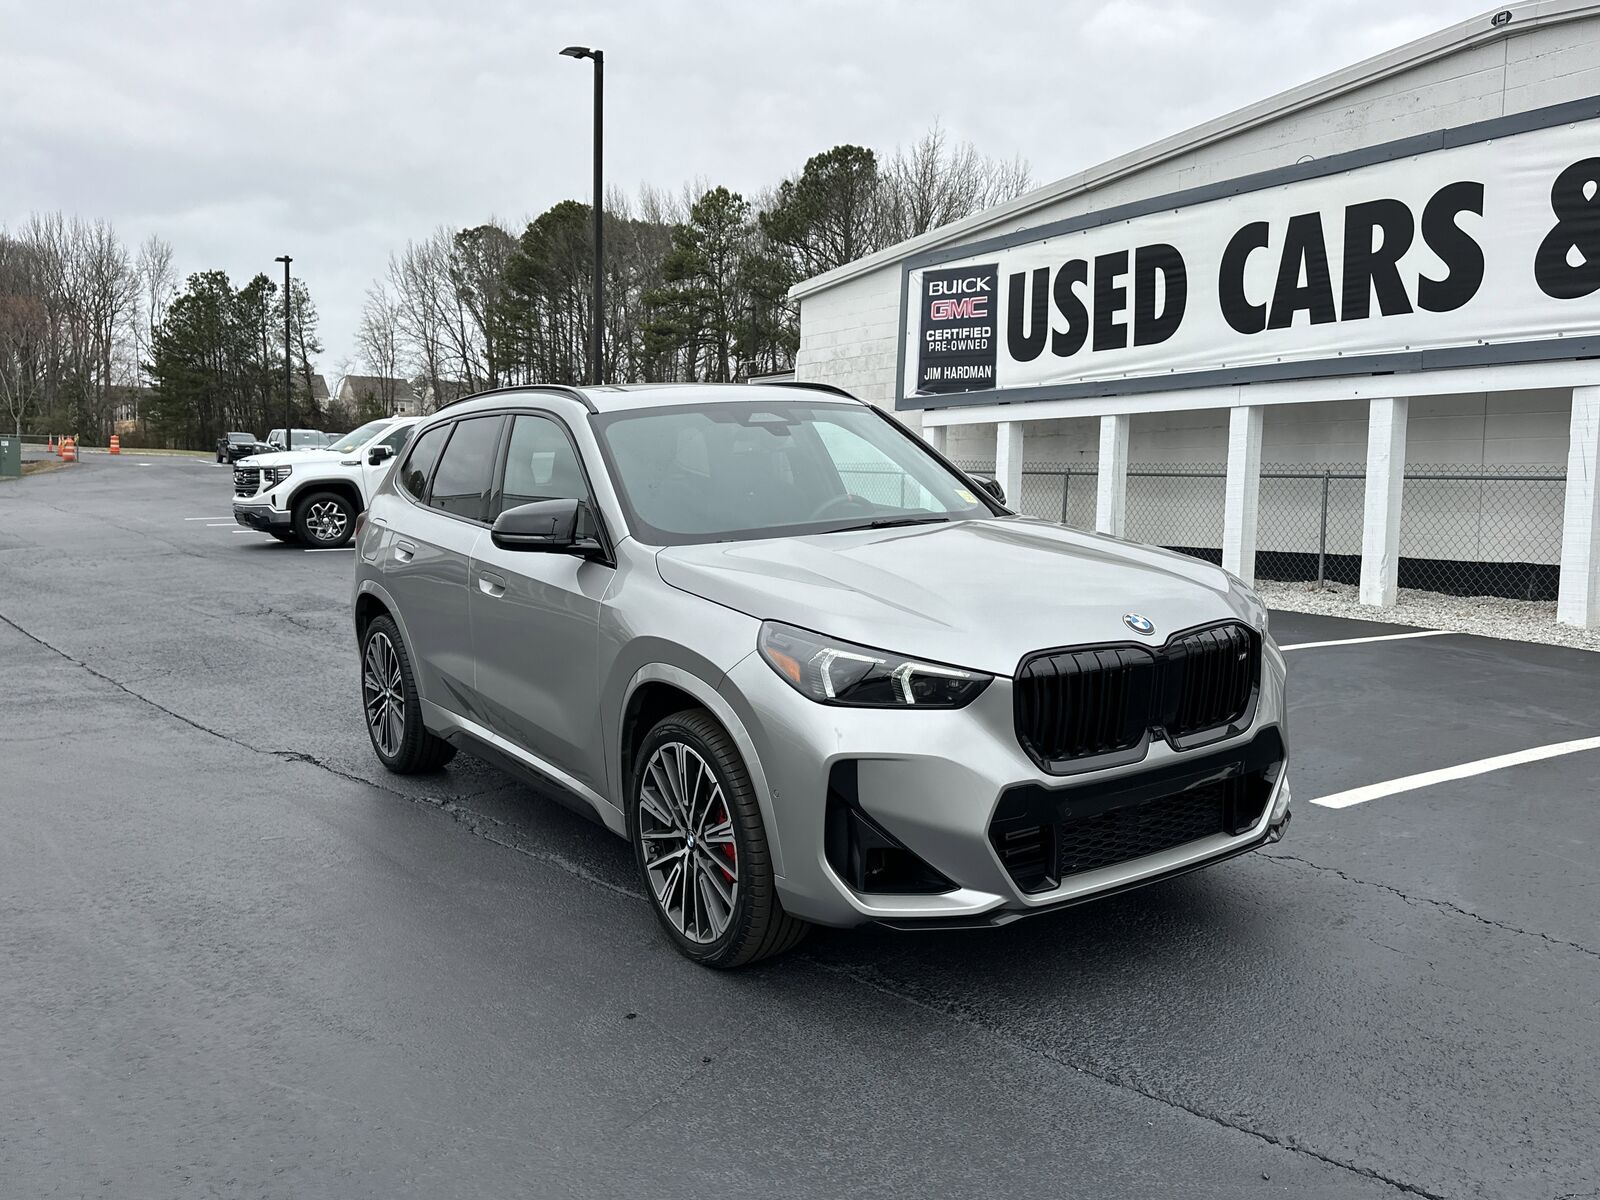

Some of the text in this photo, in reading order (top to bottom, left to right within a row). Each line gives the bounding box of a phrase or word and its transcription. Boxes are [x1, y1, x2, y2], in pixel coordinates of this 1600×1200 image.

[1007, 157, 1600, 362] USED CARS &
[928, 275, 992, 296] BUICK
[930, 295, 988, 321] GMC
[926, 326, 992, 341] CERTIFIED
[928, 338, 988, 352] PRE-OWNED
[923, 364, 992, 380] JIM HARDMAN
